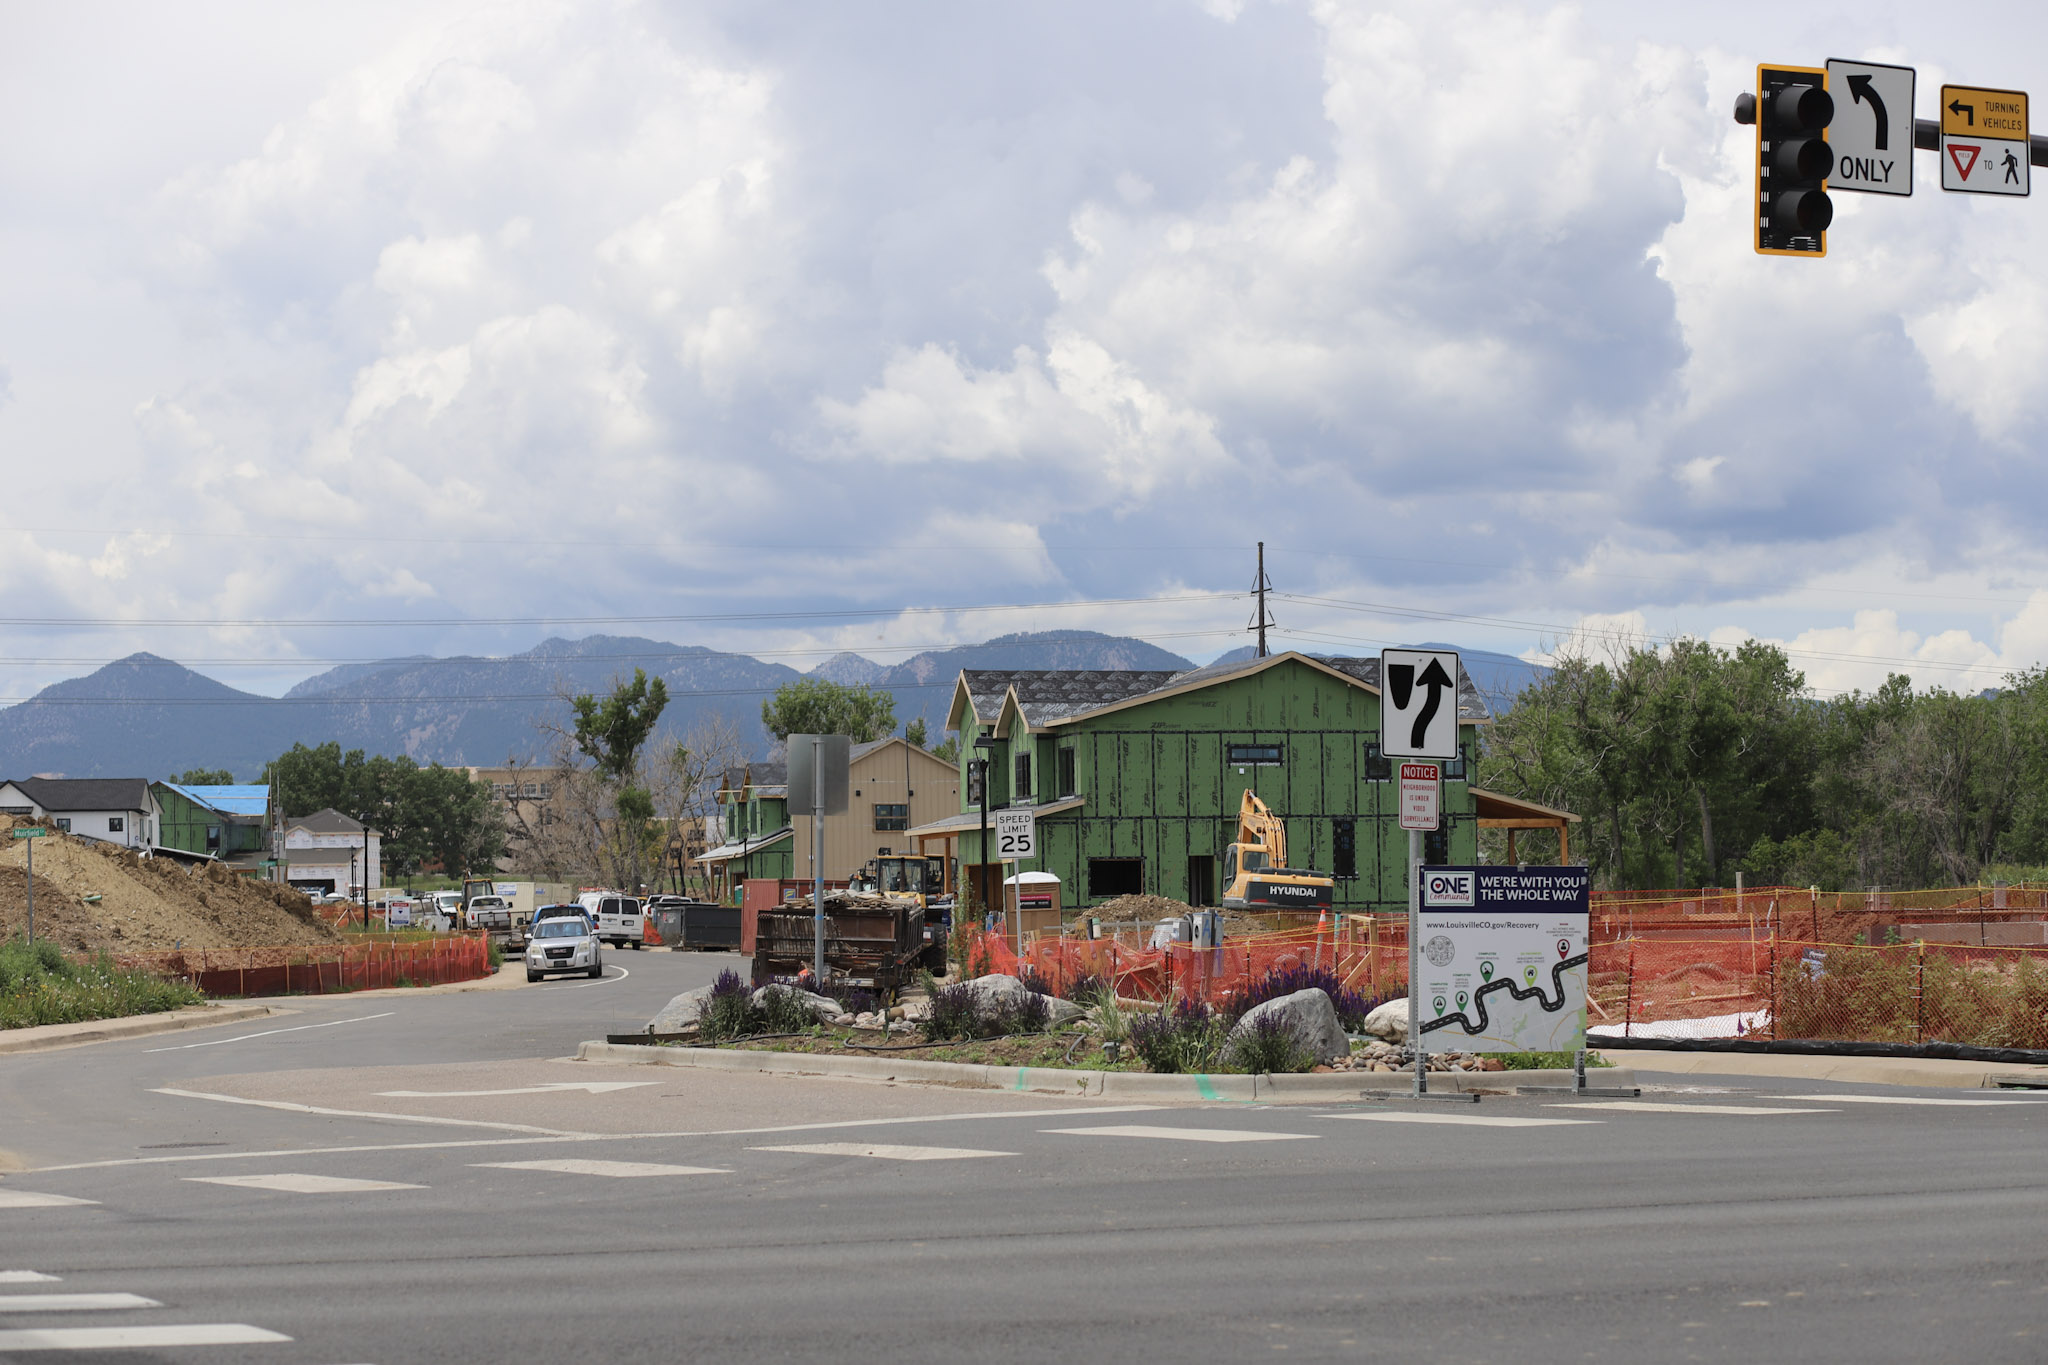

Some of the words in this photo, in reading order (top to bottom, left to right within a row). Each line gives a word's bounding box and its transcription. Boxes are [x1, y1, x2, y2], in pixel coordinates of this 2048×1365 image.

[1985, 101, 2020, 114] TURNING
[1983, 117, 2022, 131] VEHICLES
[1840, 155, 1895, 183] ONLY
[1983, 160, 1993, 171] TO
[1404, 766, 1436, 778] NOTICE
[999, 815, 1031, 824] SPEED
[1403, 815, 1435, 823] SURVEILLANCE
[1003, 825, 1027, 833] LIMIT
[1001, 834, 1031, 852] 25
[1430, 877, 1469, 894] ONE
[1519, 876, 1552, 888] WITH
[1554, 877, 1580, 888] YOU
[1270, 886, 1317, 897] HYUNDAI
[1429, 892, 1470, 902] Community
[1480, 889, 1504, 900] THE
[1506, 889, 1550, 901] WHOLE
[1552, 890, 1579, 901] WAY
[1426, 921, 1539, 930] www.LouisvilleCO.gov/Recovery
